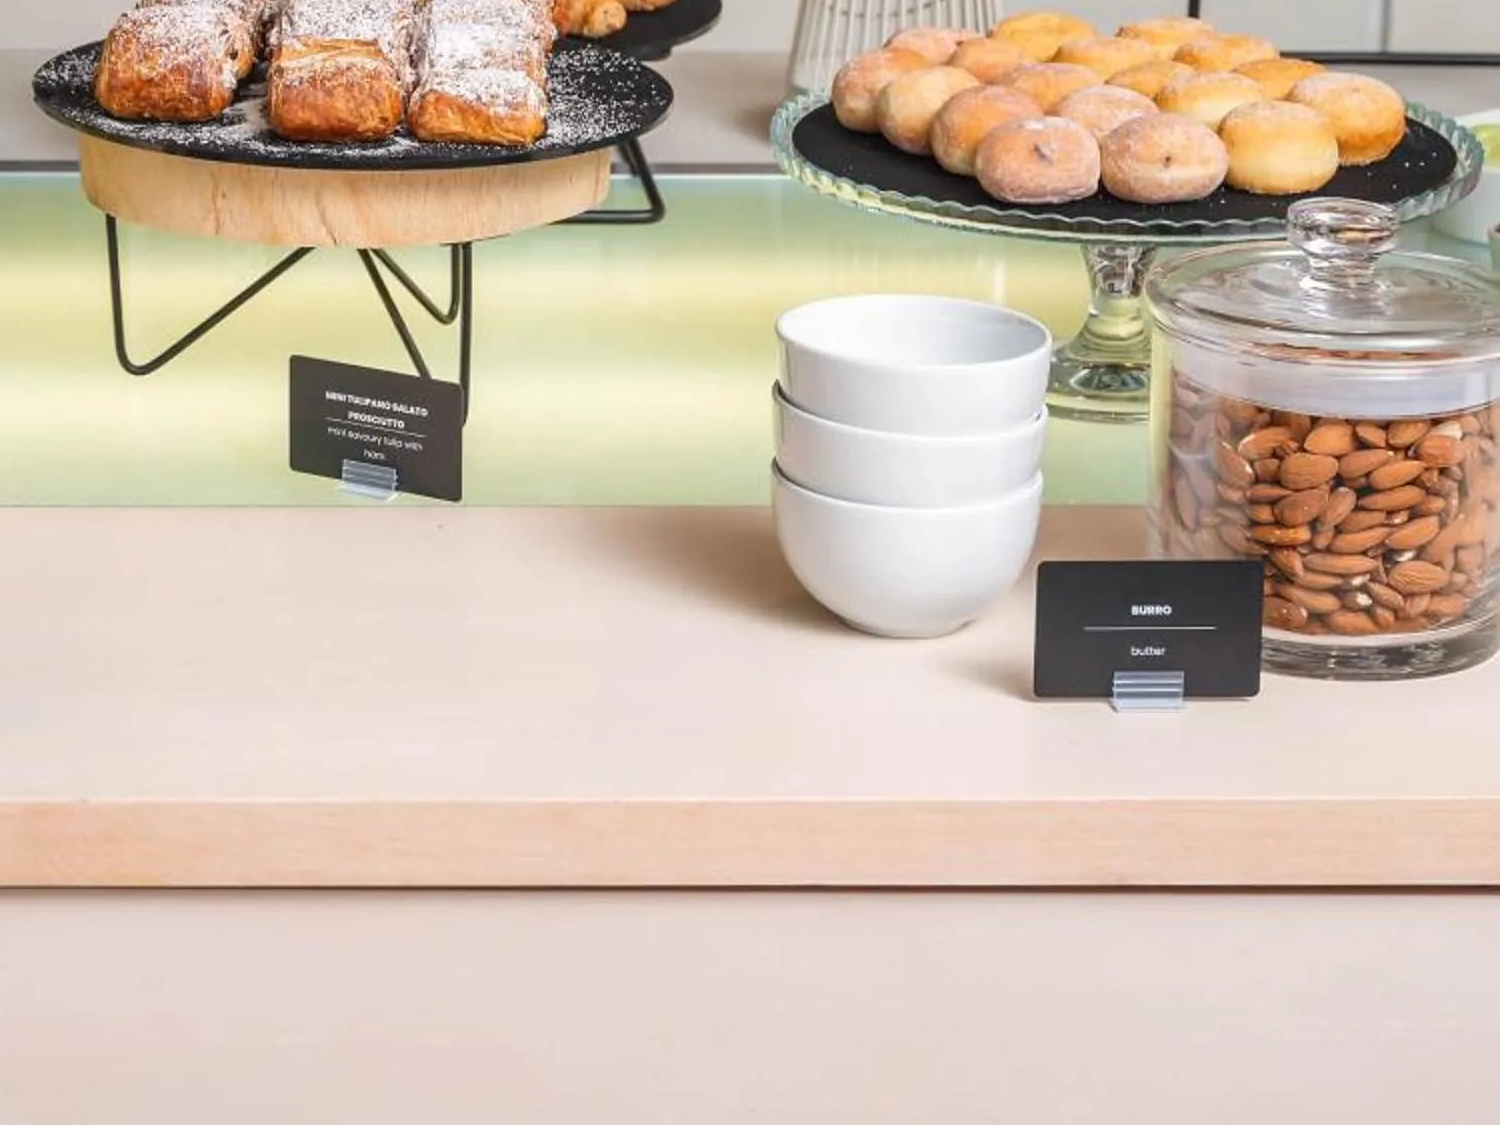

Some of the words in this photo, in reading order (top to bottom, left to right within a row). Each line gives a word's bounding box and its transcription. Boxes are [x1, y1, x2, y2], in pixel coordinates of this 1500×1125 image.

[347, 410, 405, 429] PROSCIUTTO
[1131, 605, 1172, 616] BURRO
[1131, 646, 1165, 656] butter
